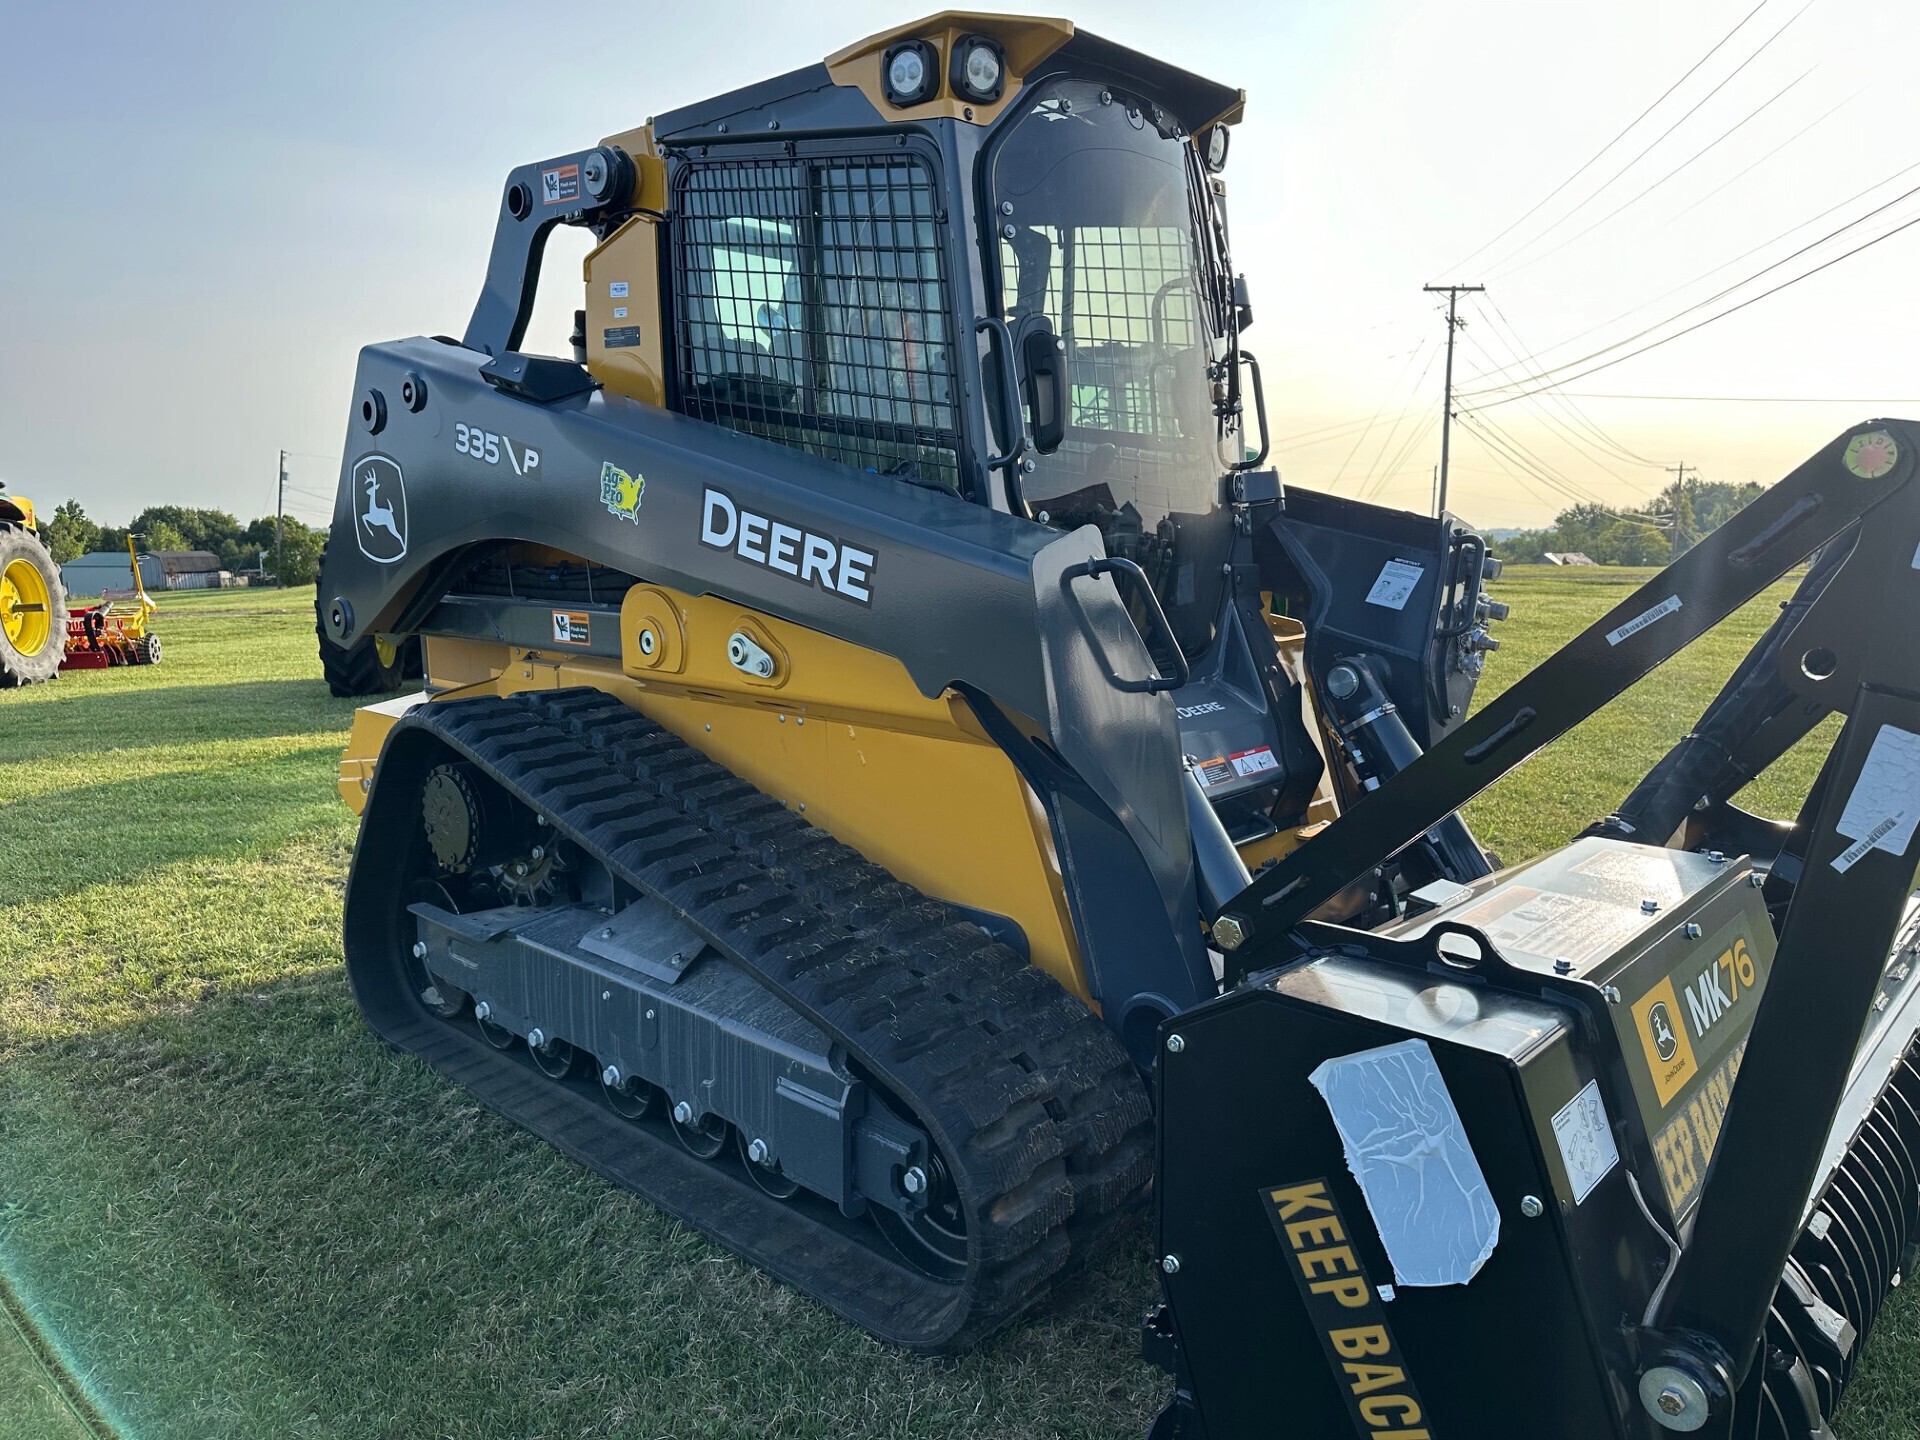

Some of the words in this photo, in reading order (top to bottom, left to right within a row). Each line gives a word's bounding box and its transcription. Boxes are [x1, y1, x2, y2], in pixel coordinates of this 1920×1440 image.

[603, 482, 623, 504] Pro
[702, 489, 874, 602] DEERE
[1176, 701, 1227, 718] DEERE
[1684, 938, 1755, 1038] MK76
[1654, 1116, 1698, 1209] EEP
[1270, 1182, 1370, 1308] KEEP
[1328, 1324, 1432, 1440] BAC
